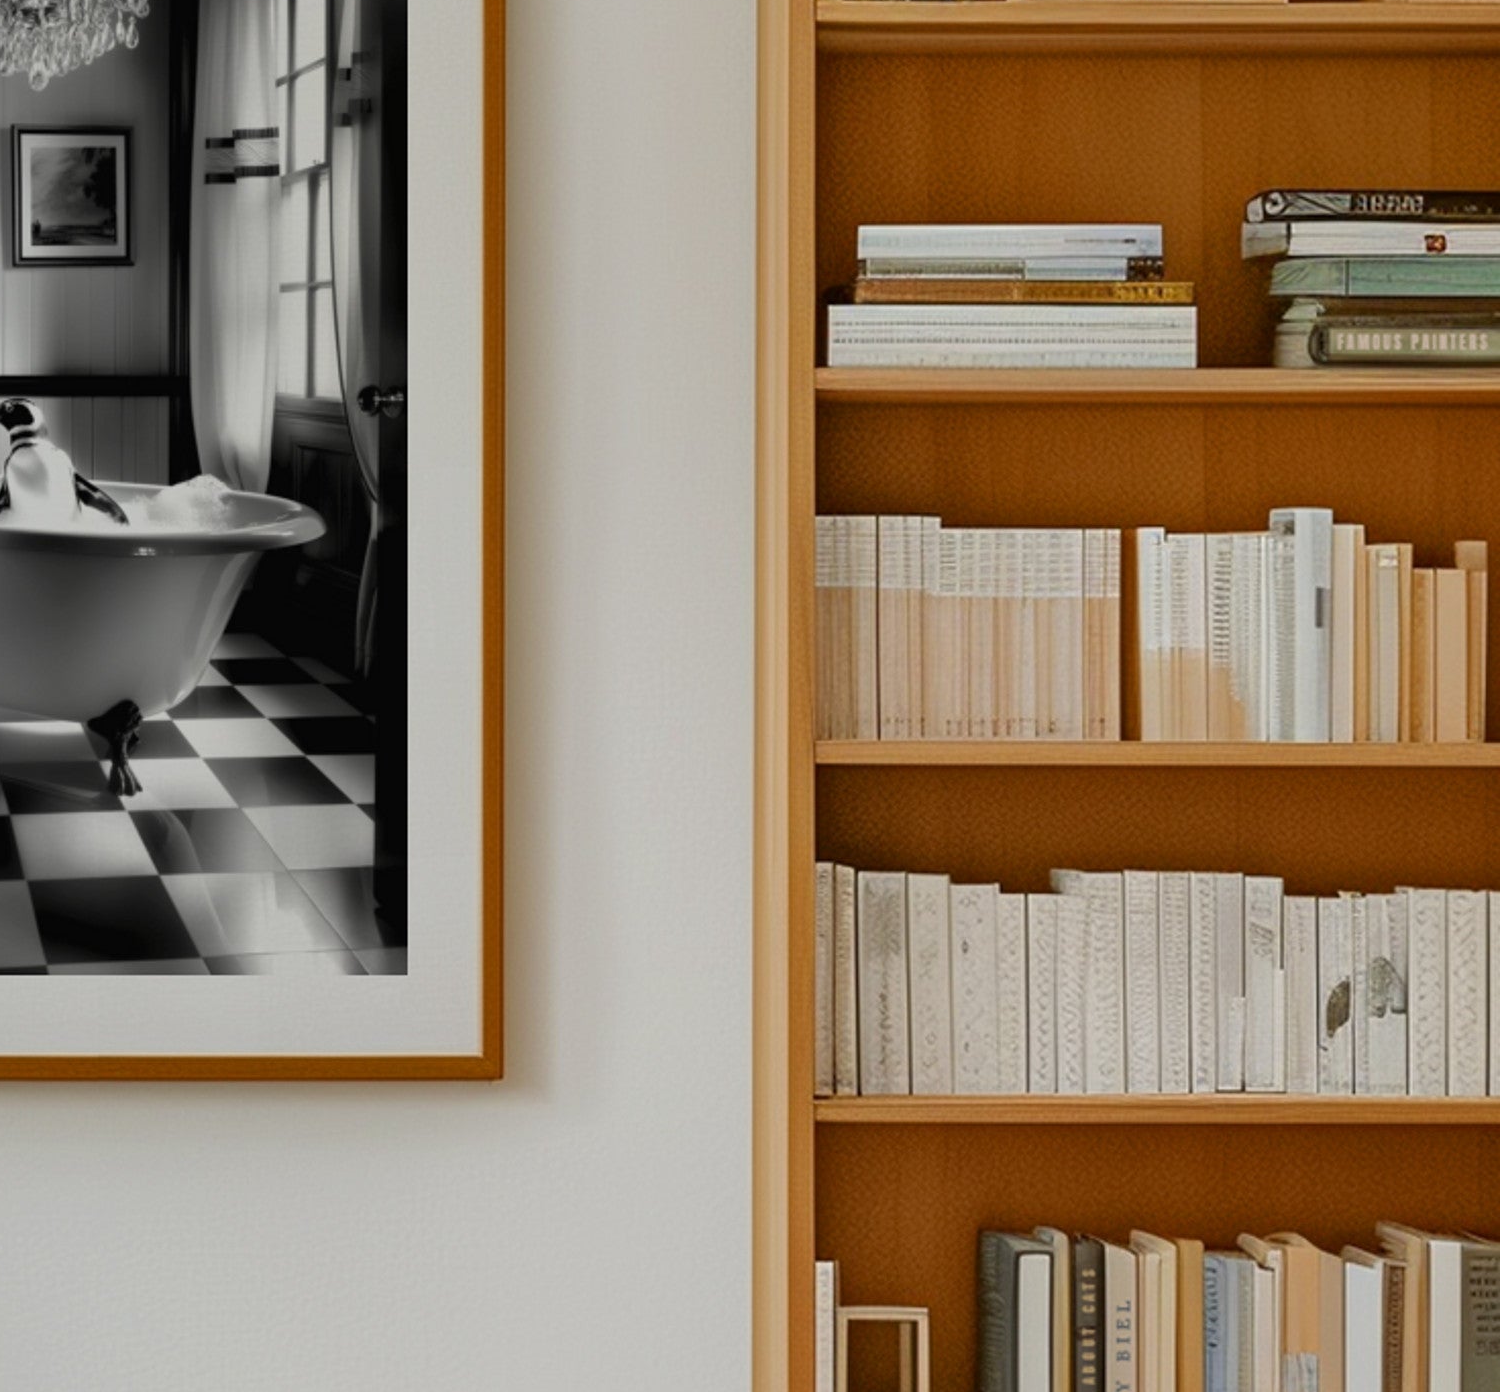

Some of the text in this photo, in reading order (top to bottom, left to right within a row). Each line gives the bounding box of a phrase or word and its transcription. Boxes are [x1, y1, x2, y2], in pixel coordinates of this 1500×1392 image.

[1336, 333, 1489, 350] FAMOUS PAINTERS
[1081, 1268, 1096, 1315] CATS
[1081, 1326, 1096, 1386] ABOUT
[1115, 1299, 1132, 1362] BIEL
